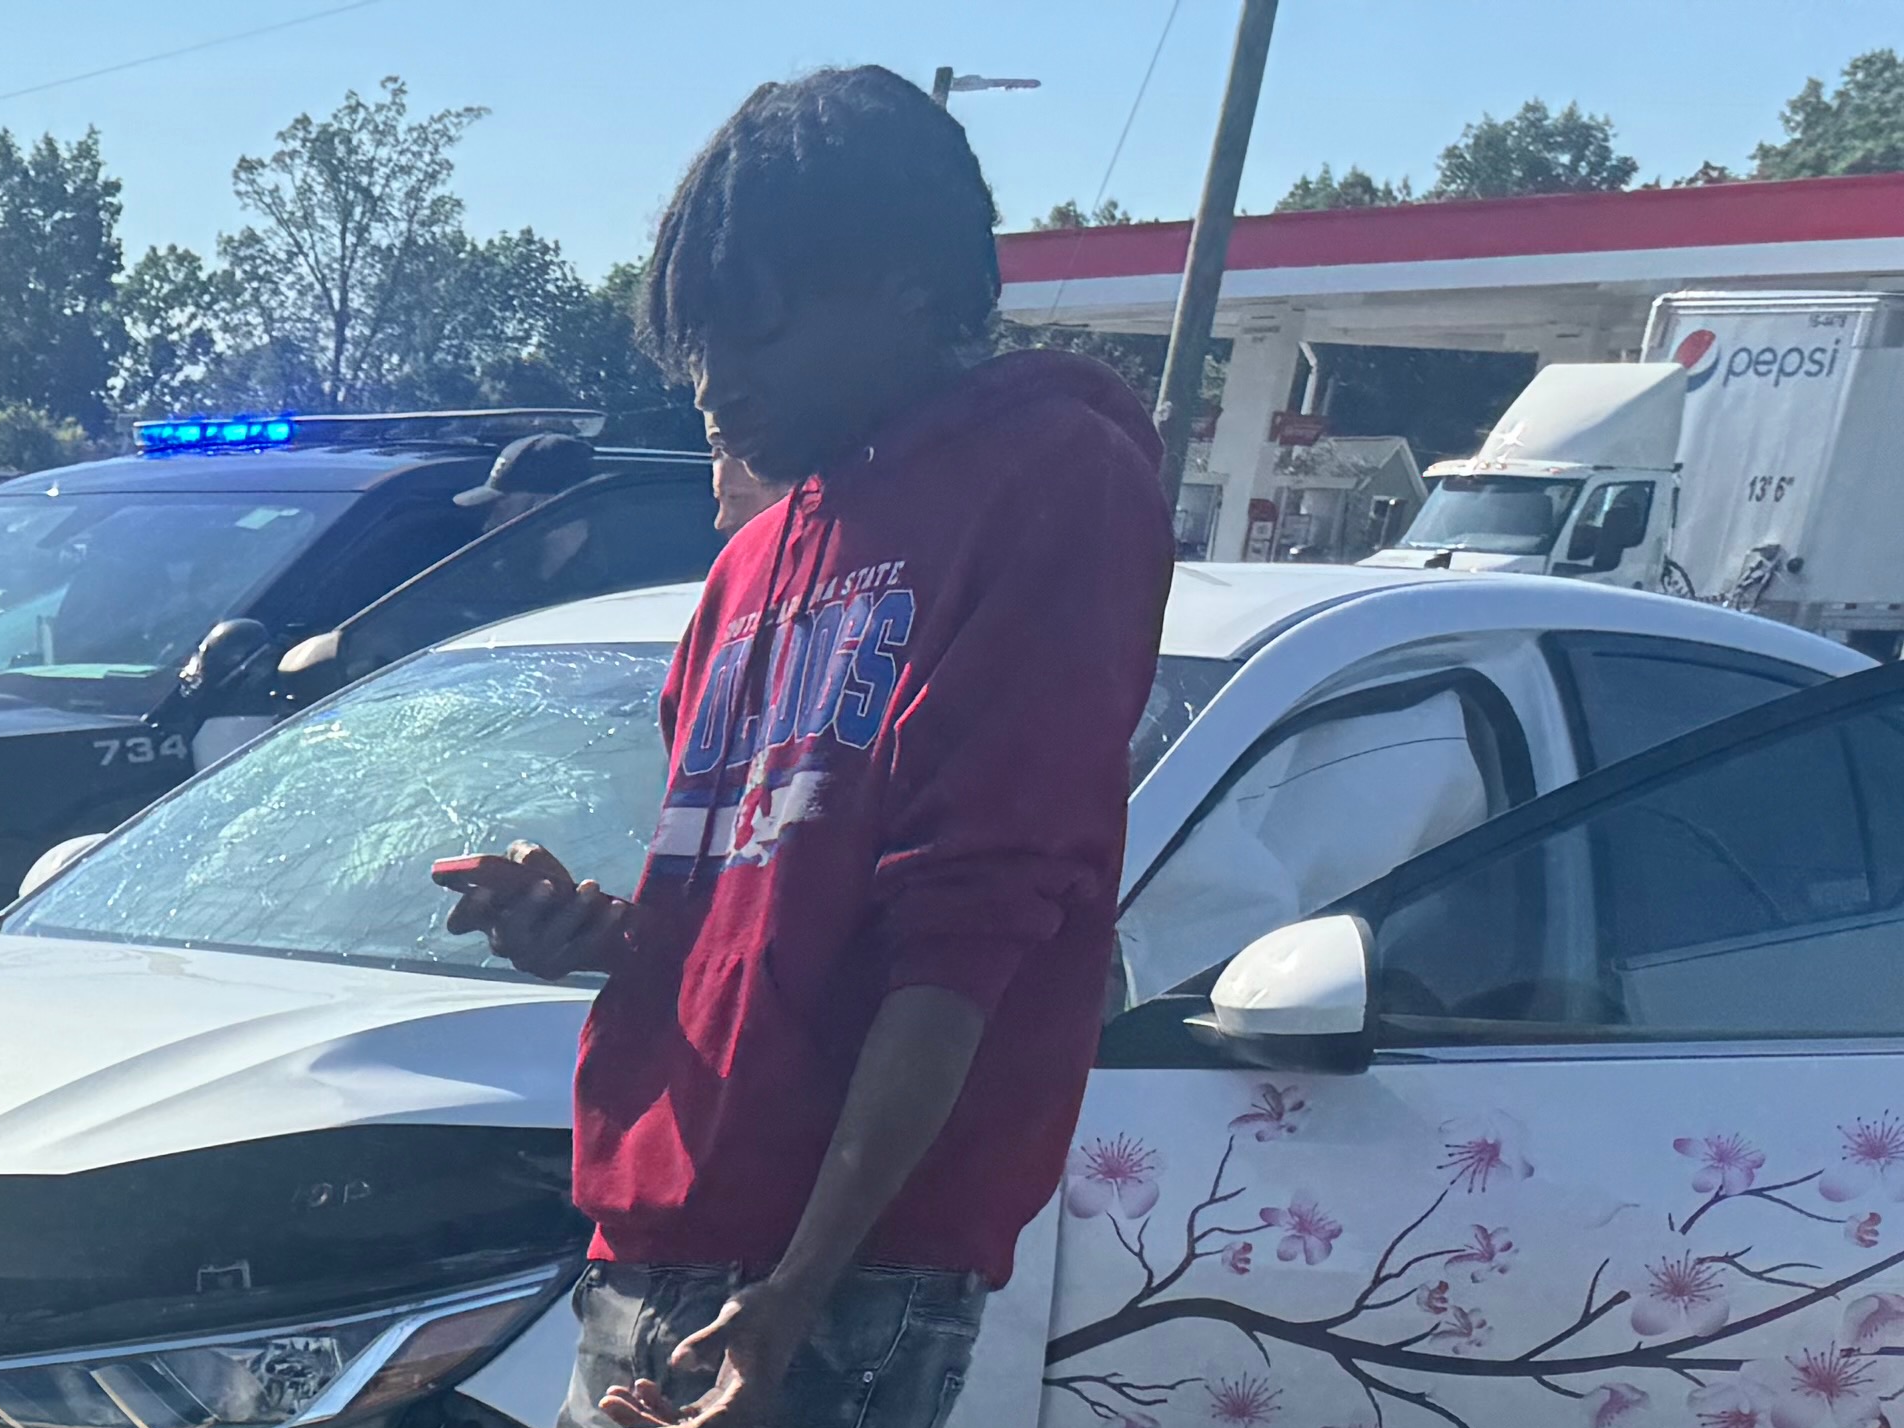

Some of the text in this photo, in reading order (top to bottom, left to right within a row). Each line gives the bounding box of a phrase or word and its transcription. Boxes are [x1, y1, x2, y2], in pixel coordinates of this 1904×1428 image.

[1722, 338, 1841, 388] pepsi
[841, 561, 906, 596] STATE
[93, 734, 188, 766] 734
